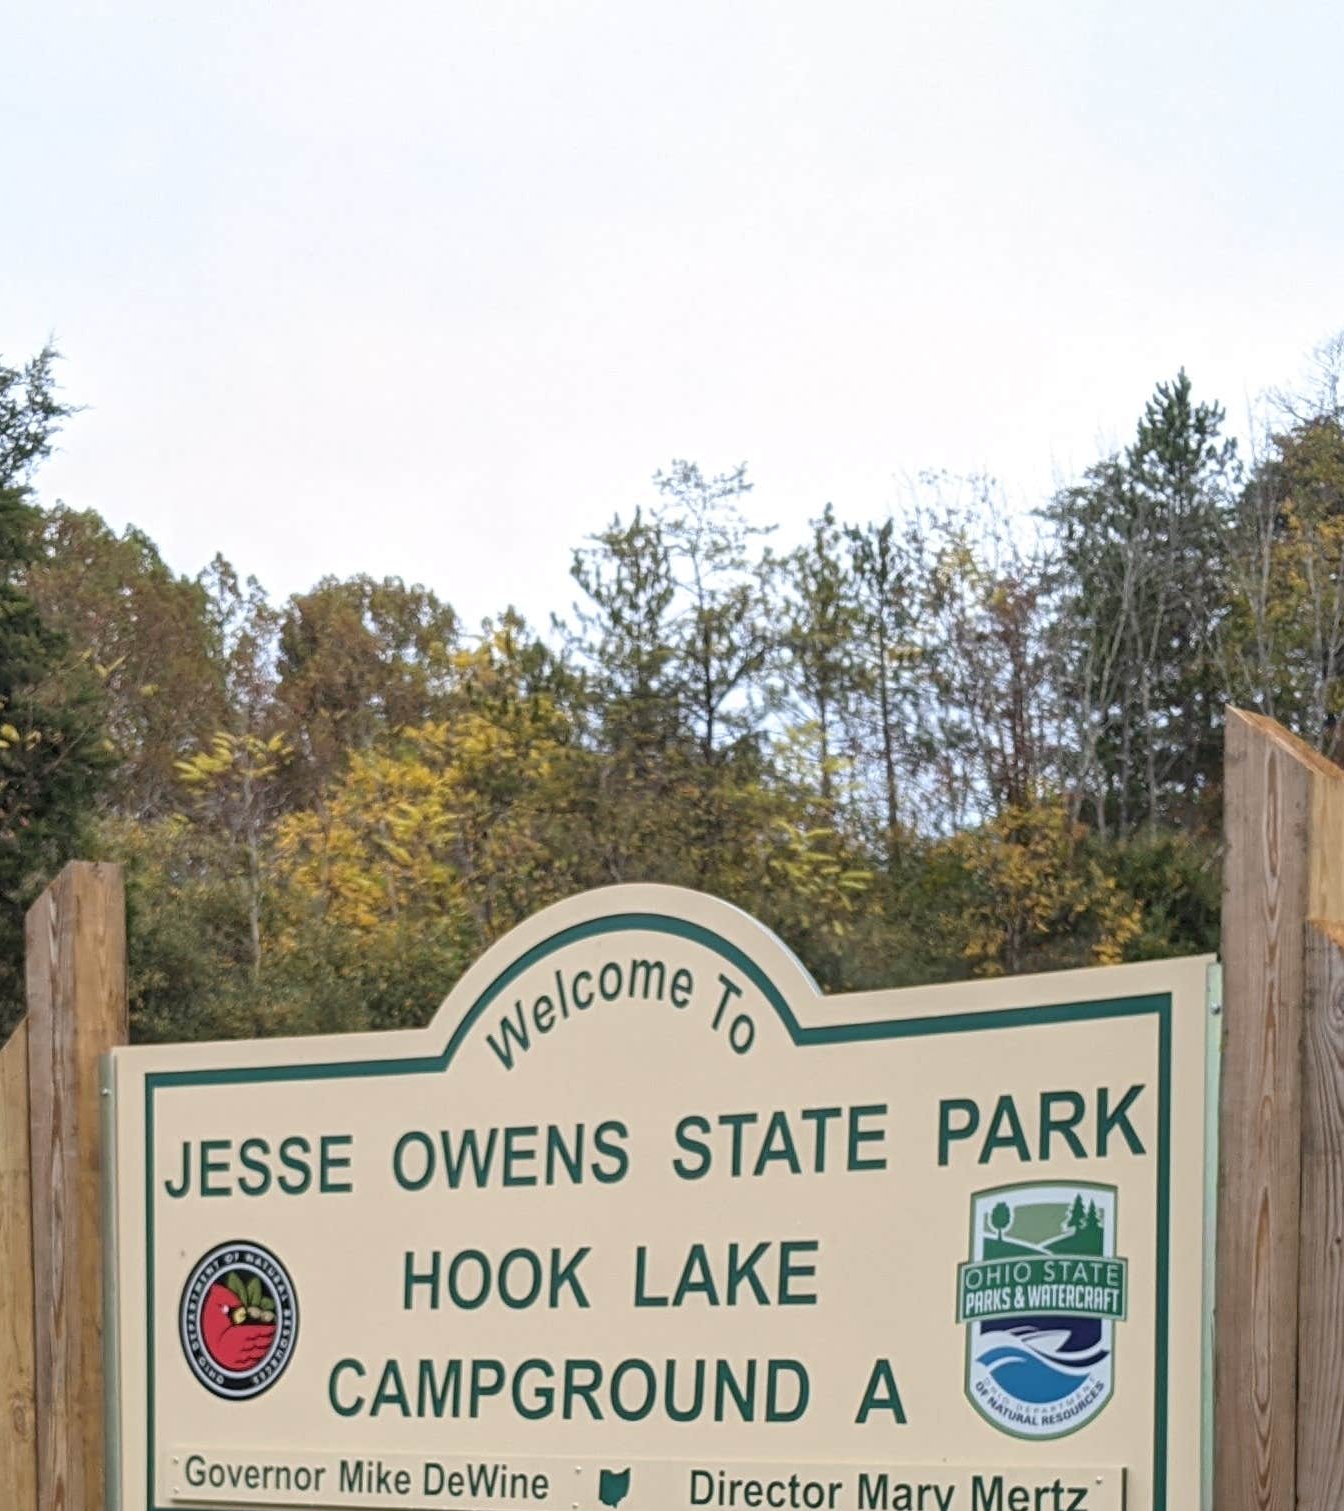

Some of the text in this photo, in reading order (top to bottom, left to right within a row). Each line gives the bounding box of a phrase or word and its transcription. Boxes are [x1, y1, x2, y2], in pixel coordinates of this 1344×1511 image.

[484, 956, 755, 1071] Welcome To
[164, 1083, 1147, 1199] JESSE OWENS STATE PARK
[402, 1240, 819, 1311] HOOK LAKE
[965, 1260, 1120, 1290] OHIO STATE
[965, 1284, 1120, 1316] PARKS & WATERCRAFT
[328, 1358, 908, 1425] CAMPGROUND A
[975, 1379, 1106, 1427] OF NATURAL RESOURCES
[185, 1454, 550, 1501] Governor Mike DeWine
[690, 1469, 843, 1511] Director
